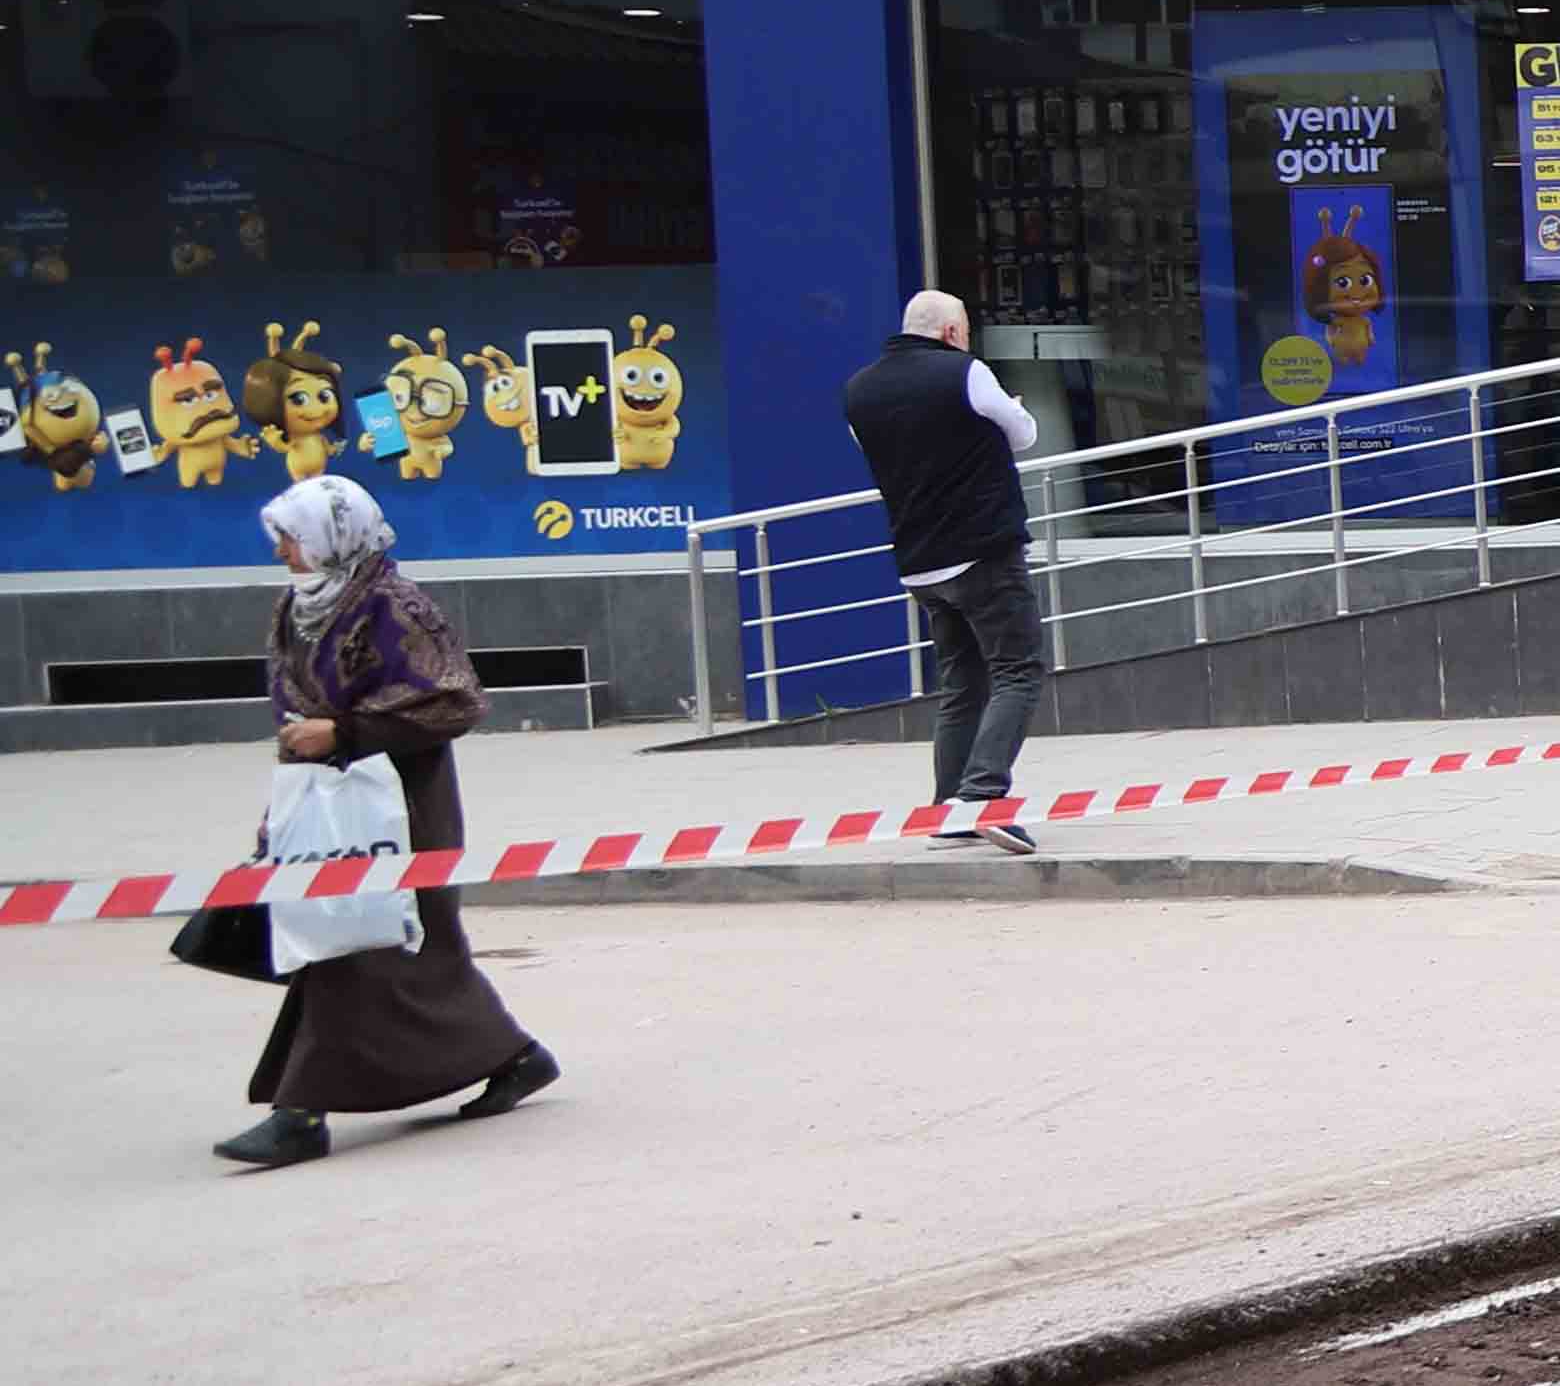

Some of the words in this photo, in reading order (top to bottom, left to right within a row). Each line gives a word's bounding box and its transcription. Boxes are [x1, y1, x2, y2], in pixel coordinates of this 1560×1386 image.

[1277, 94, 1398, 141] yeniyi
[1277, 139, 1387, 183] götür
[580, 505, 696, 530] TURKCELL
